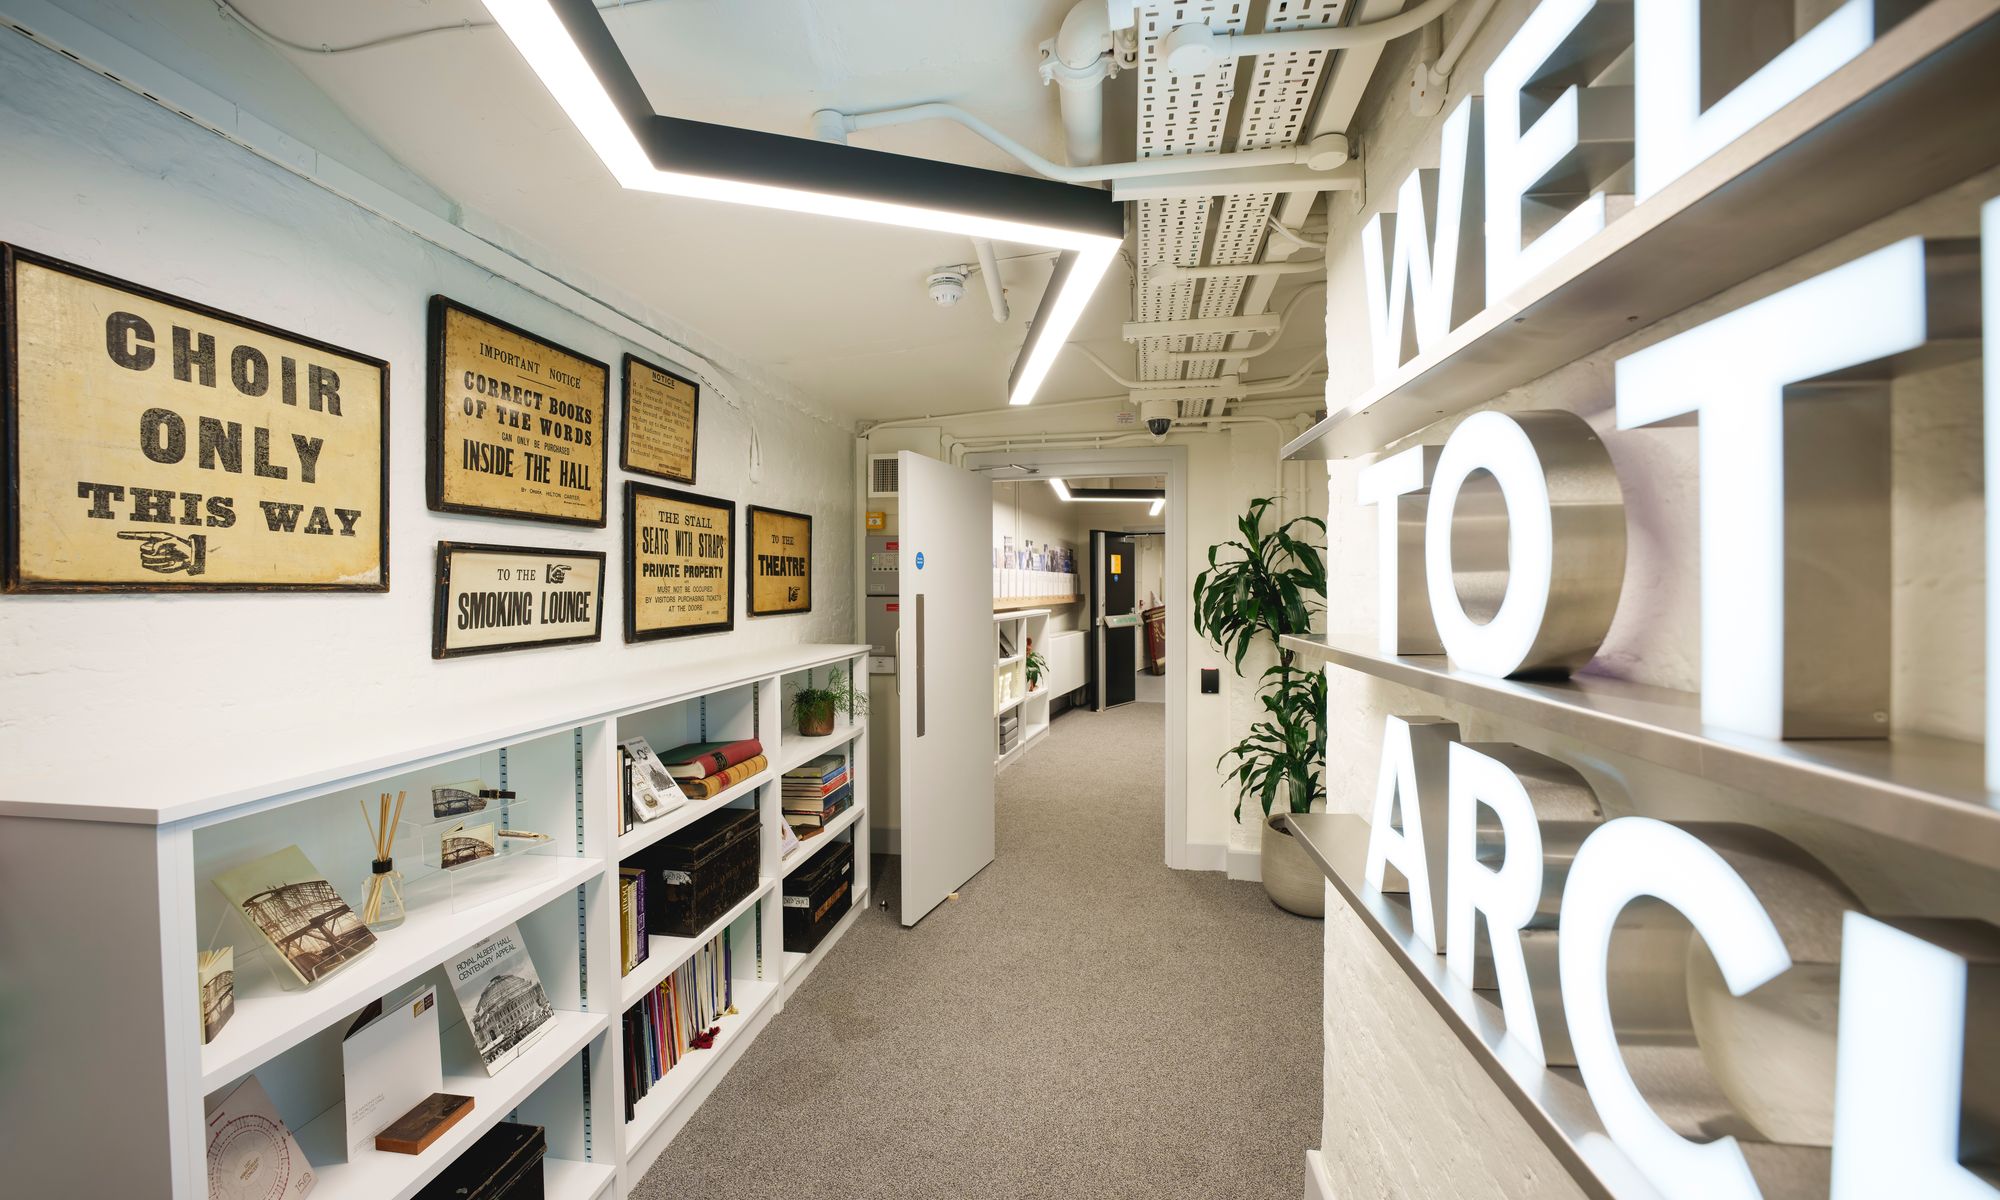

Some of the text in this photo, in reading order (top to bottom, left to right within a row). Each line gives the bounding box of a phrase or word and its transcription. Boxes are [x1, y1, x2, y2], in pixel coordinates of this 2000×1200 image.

[105, 311, 343, 417] CHOIR
[480, 342, 581, 389] IMPORTANT NOTICE
[652, 371, 675, 386] NOTICE
[464, 370, 542, 410] CORRECT
[549, 397, 592, 425] BOOKS
[463, 396, 592, 446] OF THE WORDS
[140, 407, 324, 484] ONLY
[502, 432, 570, 455] CAN ONLY BE PURCHASED
[463, 438, 591, 491] INSIDE THE HALL
[77, 482, 362, 537] THIS WAY
[1358, 190, 2000, 810] TO T
[658, 511, 712, 528] THE STALL
[642, 526, 723, 559] SEATS WITH STRAPS
[771, 534, 794, 545] TO THE
[497, 569, 536, 581] TO THE
[642, 563, 723, 578] PRIVATE PROPERTY
[758, 554, 805, 576] THEATRE
[457, 591, 591, 630] SMOKING LOUNGE
[456, 957, 476, 971] ROYAL
[476, 943, 497, 960] ALBERT
[497, 936, 511, 948] HALL
[458, 955, 494, 981] CENTENARY
[495, 943, 516, 959] APPEAL
[1365, 714, 2000, 1200] ARC
